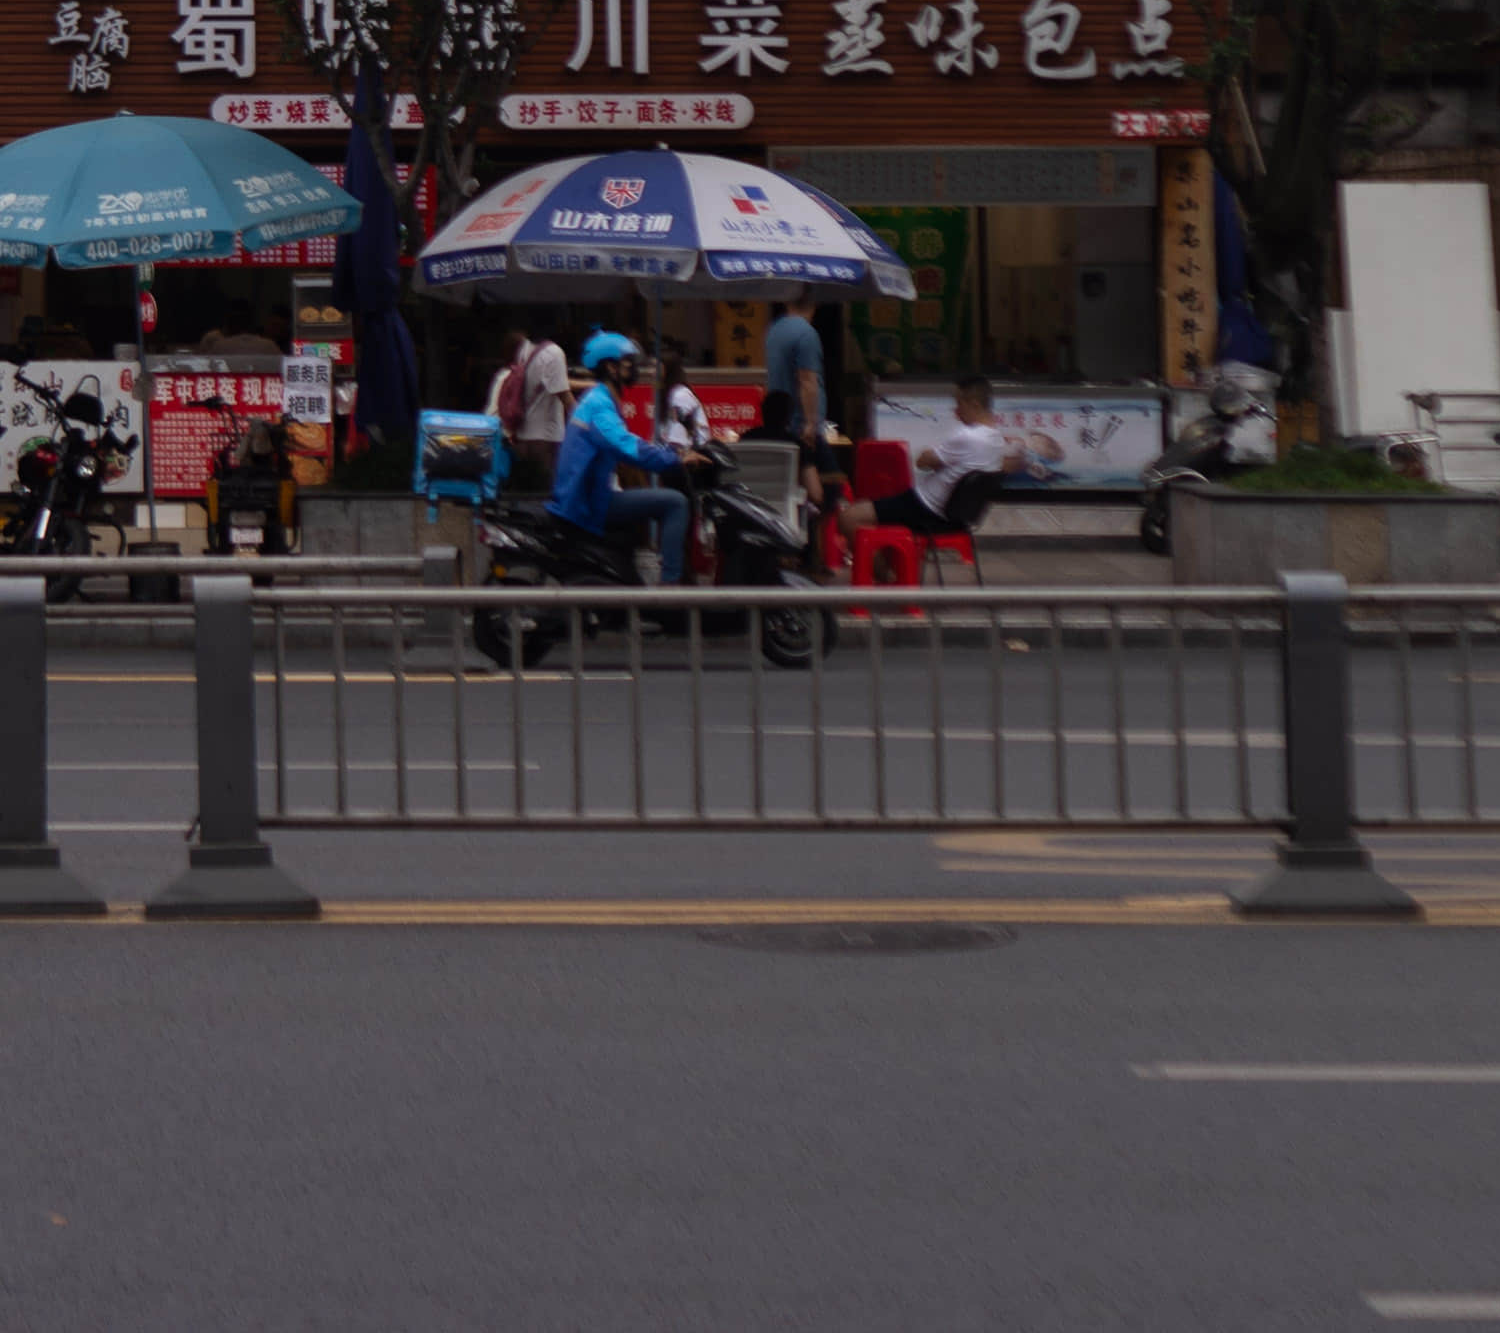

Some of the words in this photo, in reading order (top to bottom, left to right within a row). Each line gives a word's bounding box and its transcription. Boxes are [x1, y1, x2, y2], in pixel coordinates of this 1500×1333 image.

[551, 207, 674, 233] 山木培训
[85, 229, 215, 261] 400-028-0072
[287, 364, 330, 384] 服务员
[154, 376, 238, 407] 军屯锅盔
[288, 395, 328, 416] 招聘
